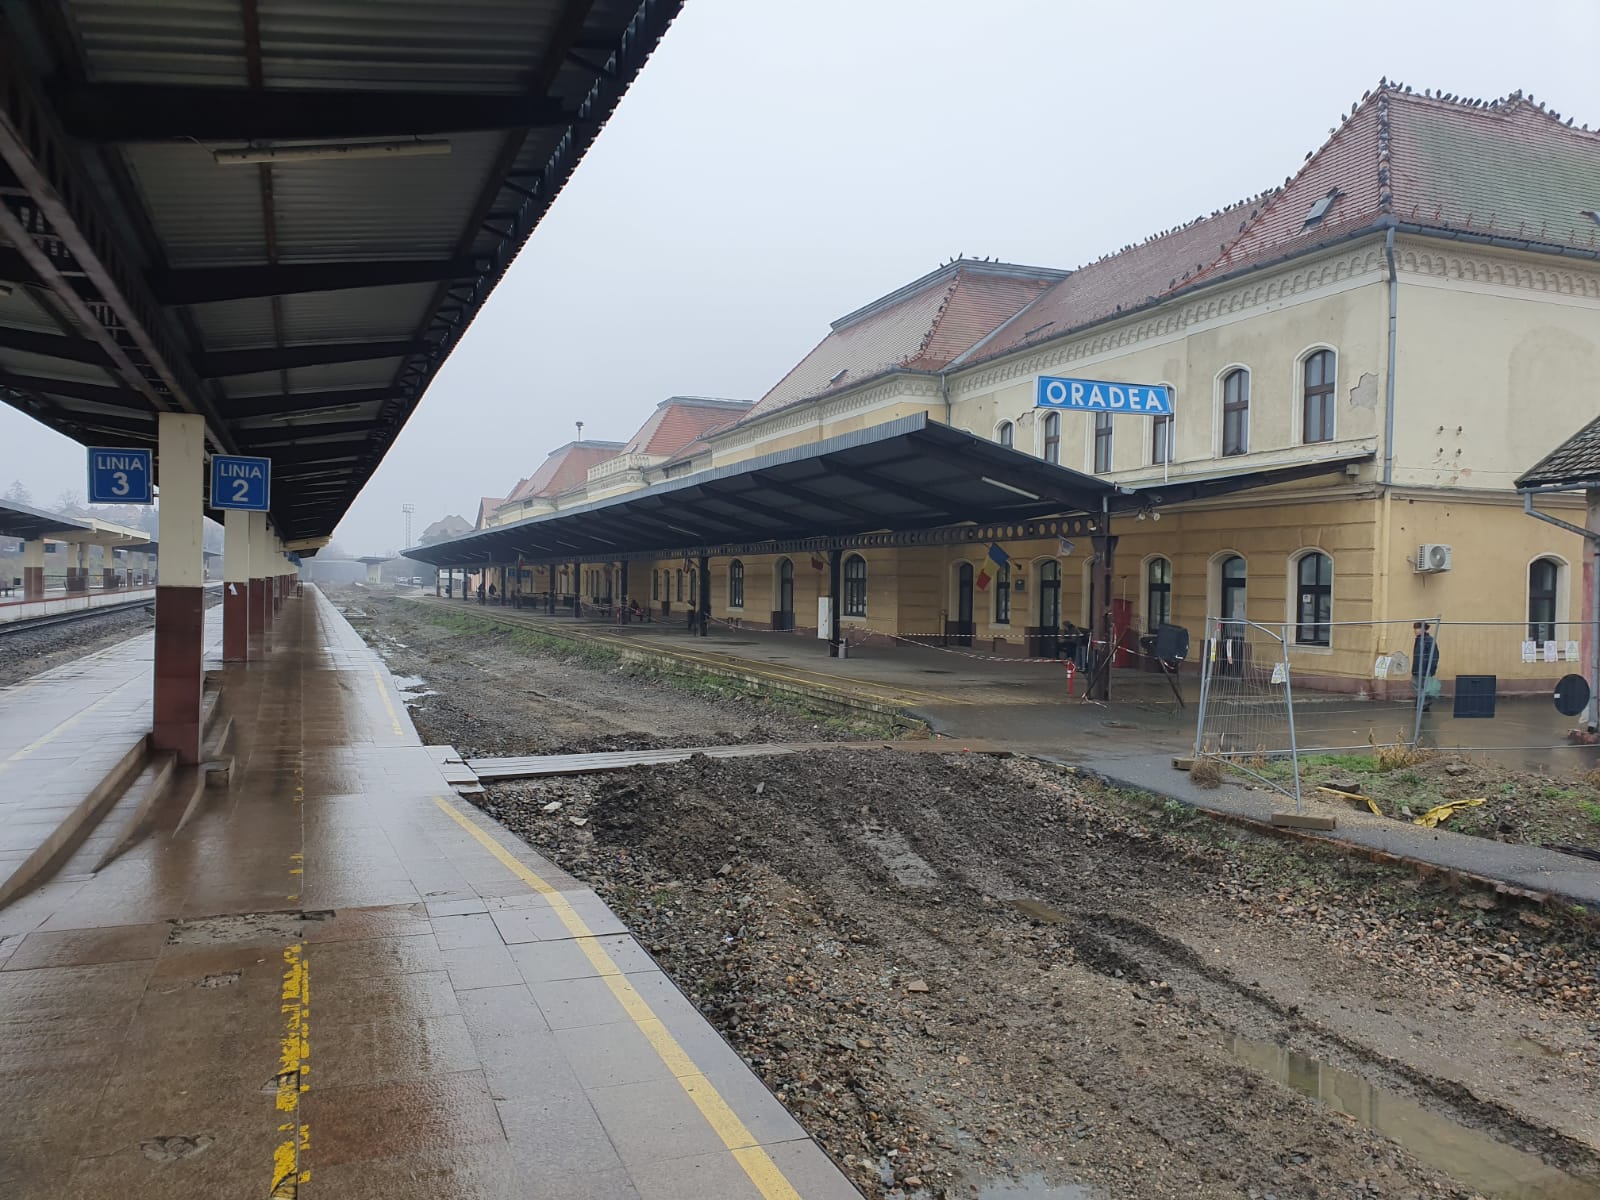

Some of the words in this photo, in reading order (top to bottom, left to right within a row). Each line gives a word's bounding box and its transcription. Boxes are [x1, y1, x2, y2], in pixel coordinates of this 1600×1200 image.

[1047, 382, 1163, 410] ORADEA
[98, 456, 144, 471] LINIA
[220, 463, 262, 479] LINIA
[112, 472, 130, 496] 3
[232, 480, 249, 502] 2
